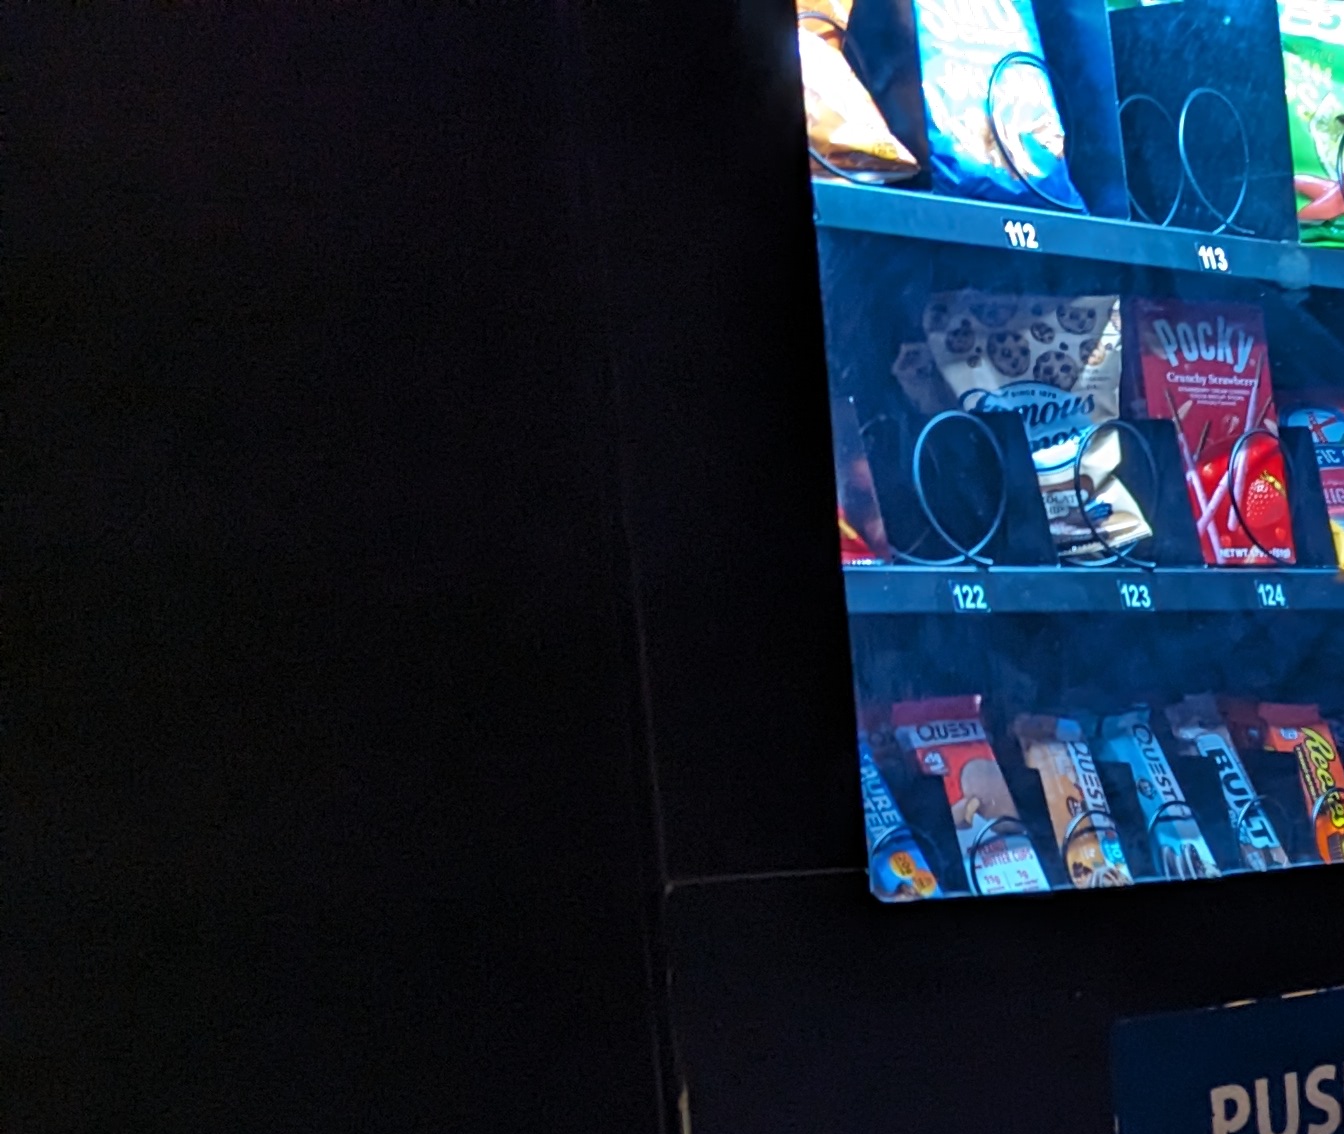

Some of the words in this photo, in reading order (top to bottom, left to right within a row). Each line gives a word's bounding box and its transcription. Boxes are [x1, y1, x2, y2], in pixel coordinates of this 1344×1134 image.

[1004, 220, 1039, 250] 112
[1198, 244, 1229, 272] 113
[953, 584, 988, 611] 122
[1120, 583, 1151, 609] 123
[1257, 583, 1286, 606] 124
[915, 720, 980, 742] QUEST
[1132, 723, 1180, 802] QUEST
[1070, 740, 1111, 815] QUEST
